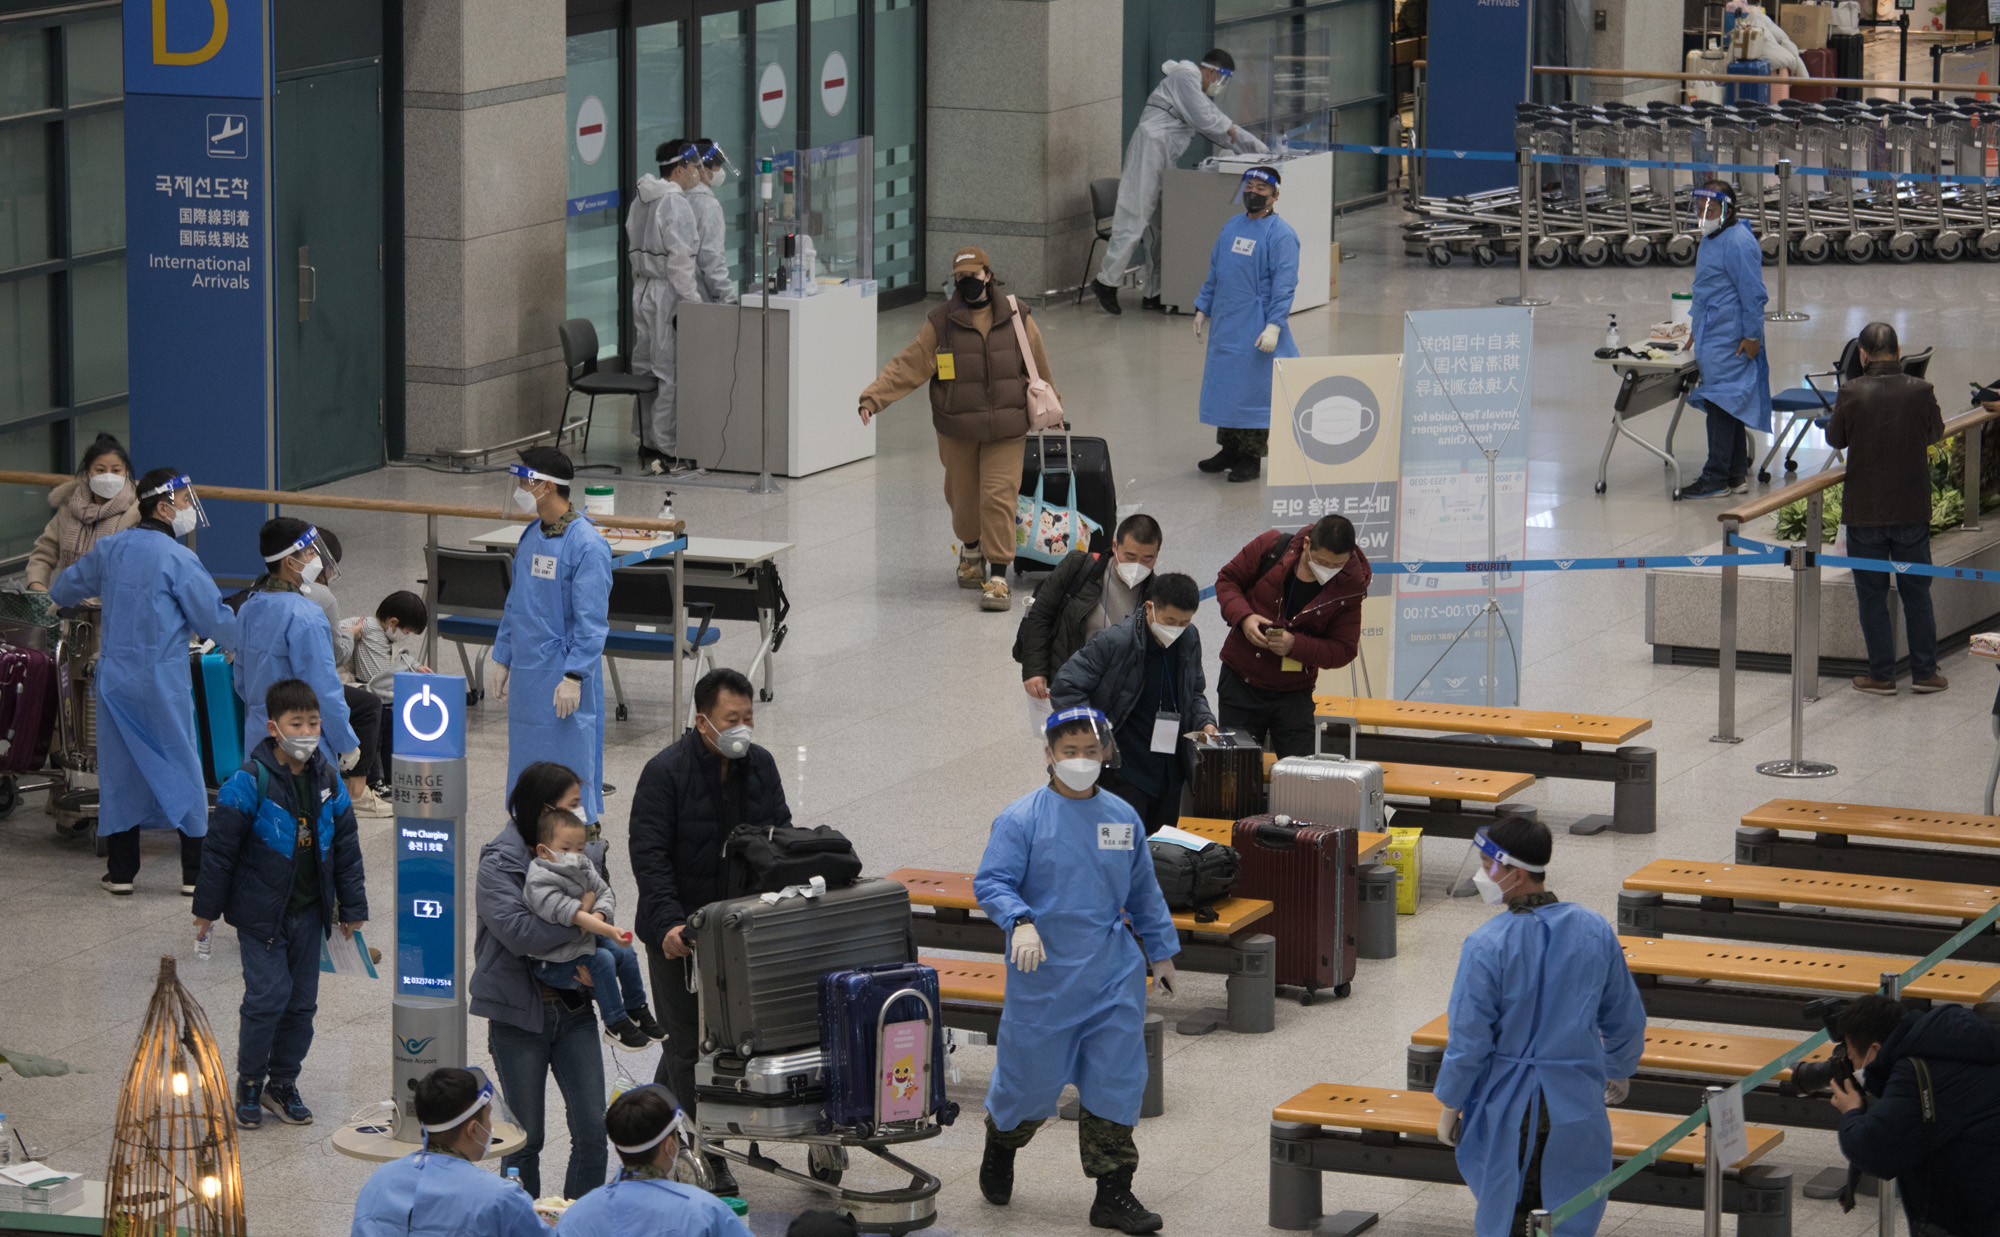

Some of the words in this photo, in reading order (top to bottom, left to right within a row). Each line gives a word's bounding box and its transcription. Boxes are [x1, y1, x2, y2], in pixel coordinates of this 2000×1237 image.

[152, 0, 228, 66] D
[1828, 164, 1860, 177] SECURITY
[155, 175, 249, 200] 국제선도착
[179, 208, 250, 227] 国際線到着
[179, 229, 250, 249] 国际线到达
[149, 253, 250, 272] International
[192, 273, 250, 290] Arrivals
[1465, 562, 1512, 572] SECURITY
[394, 771, 443, 787] CHARGE
[402, 828, 418, 838] Free
[417, 829, 449, 841] Charging
[1101, 827, 1110, 838] 육
[407, 841, 423, 852] 충전
[410, 977, 452, 987] 032)741-7514
[414, 1057, 437, 1065] Airport
